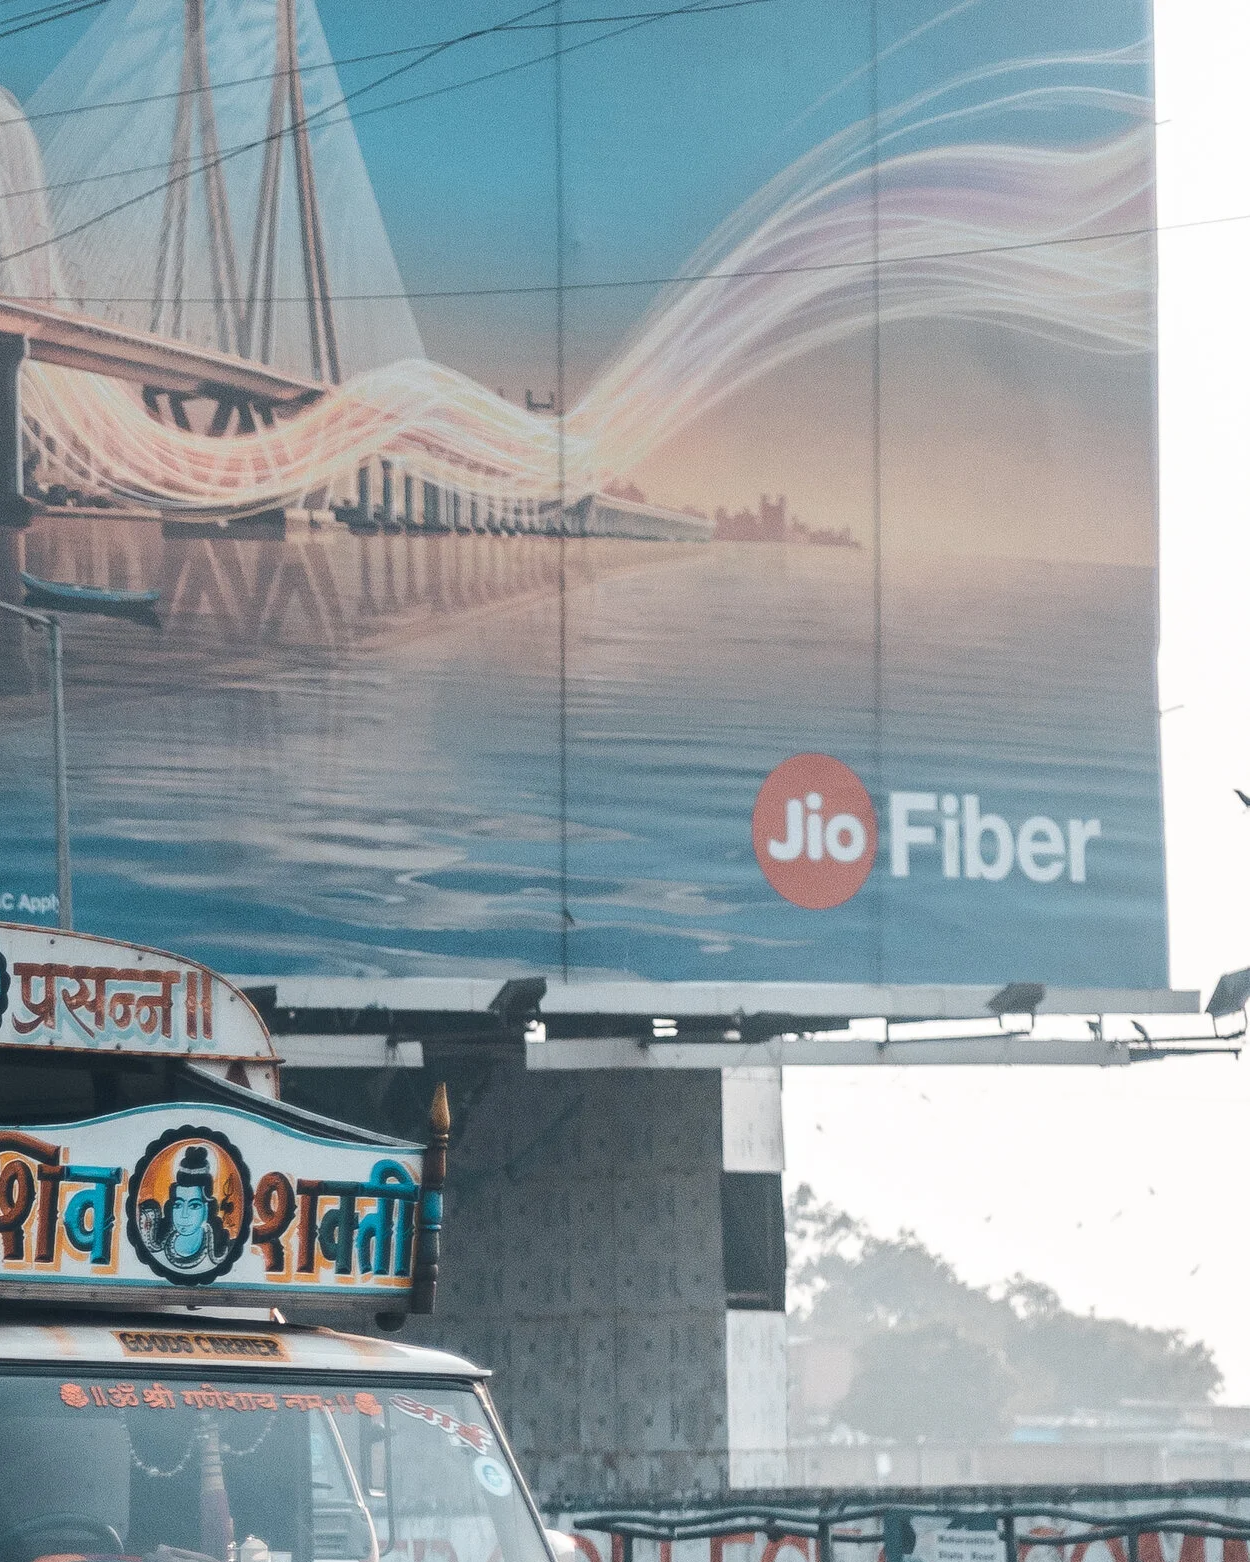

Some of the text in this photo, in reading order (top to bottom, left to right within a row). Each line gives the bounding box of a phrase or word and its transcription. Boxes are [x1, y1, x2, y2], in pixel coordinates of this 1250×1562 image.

[768, 791, 867, 863] Jio
[889, 791, 1102, 882] Fiber
[119, 1332, 282, 1357] GOODS CARRIER
